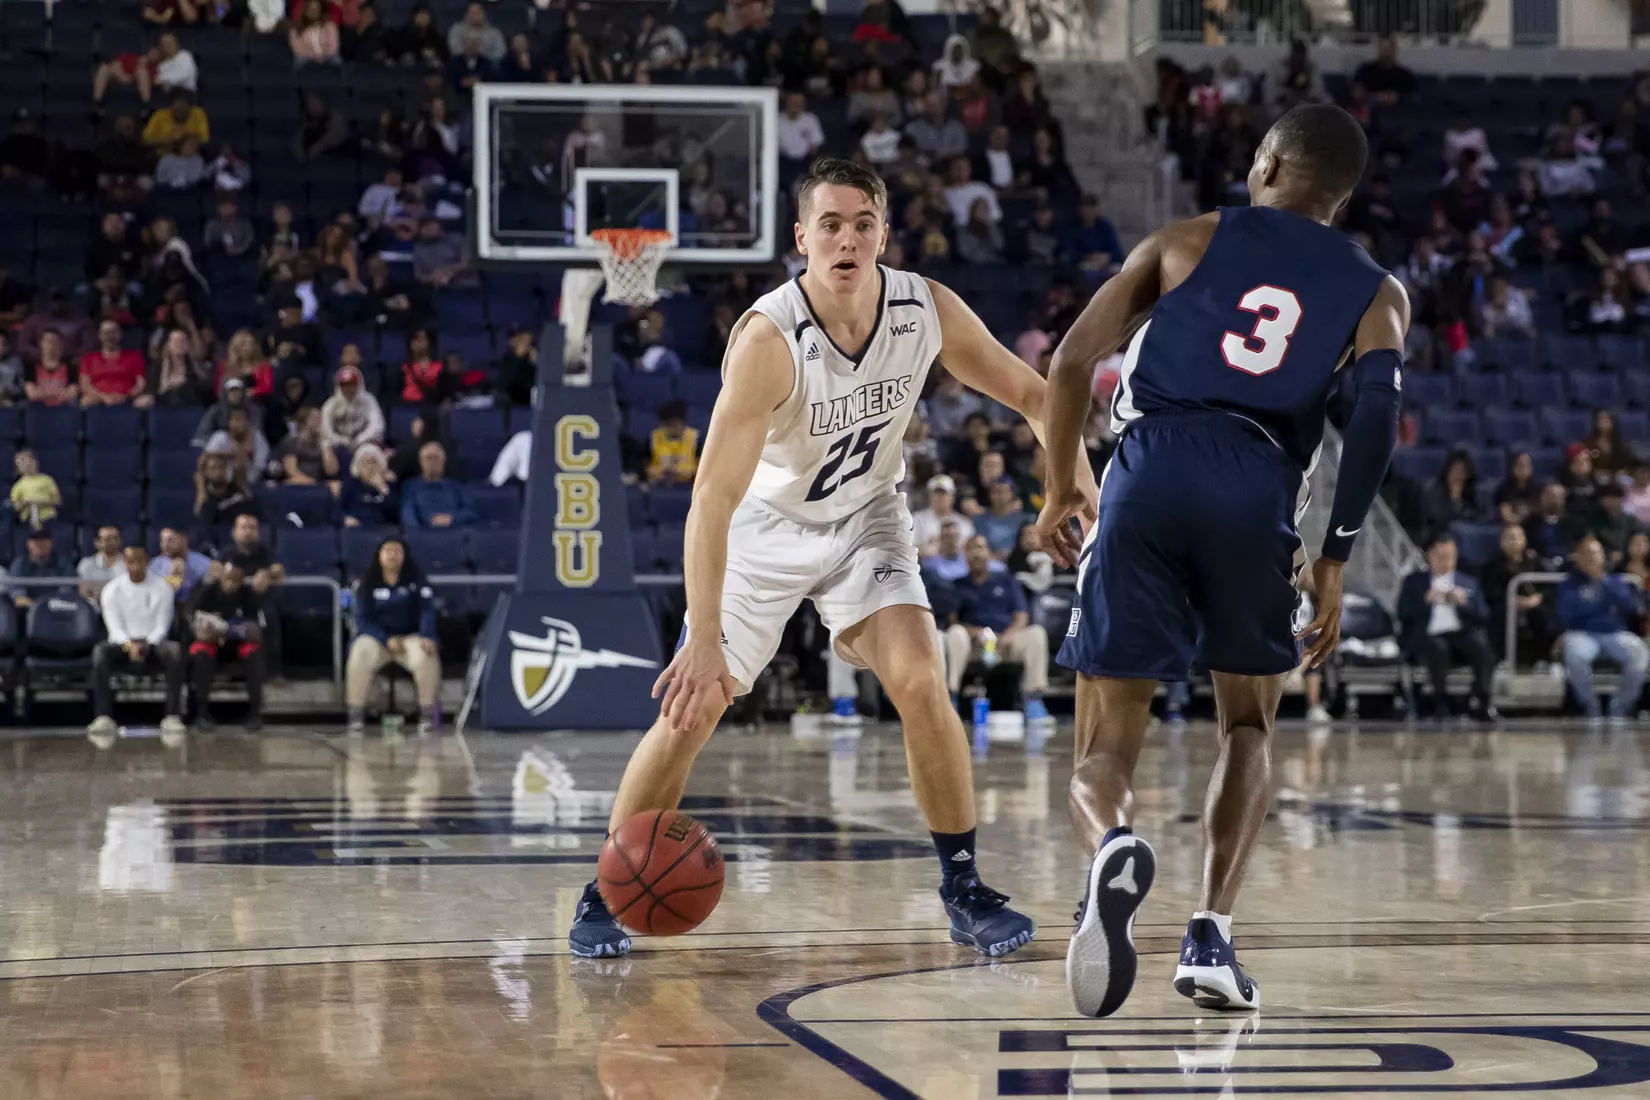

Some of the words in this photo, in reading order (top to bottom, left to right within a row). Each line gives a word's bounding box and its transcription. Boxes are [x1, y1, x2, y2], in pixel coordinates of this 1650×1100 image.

[889, 321, 917, 337] WAC
[1220, 284, 1304, 377] 3
[810, 374, 912, 436] LANCERS
[552, 414, 603, 588] CBU
[804, 416, 895, 502] 25
